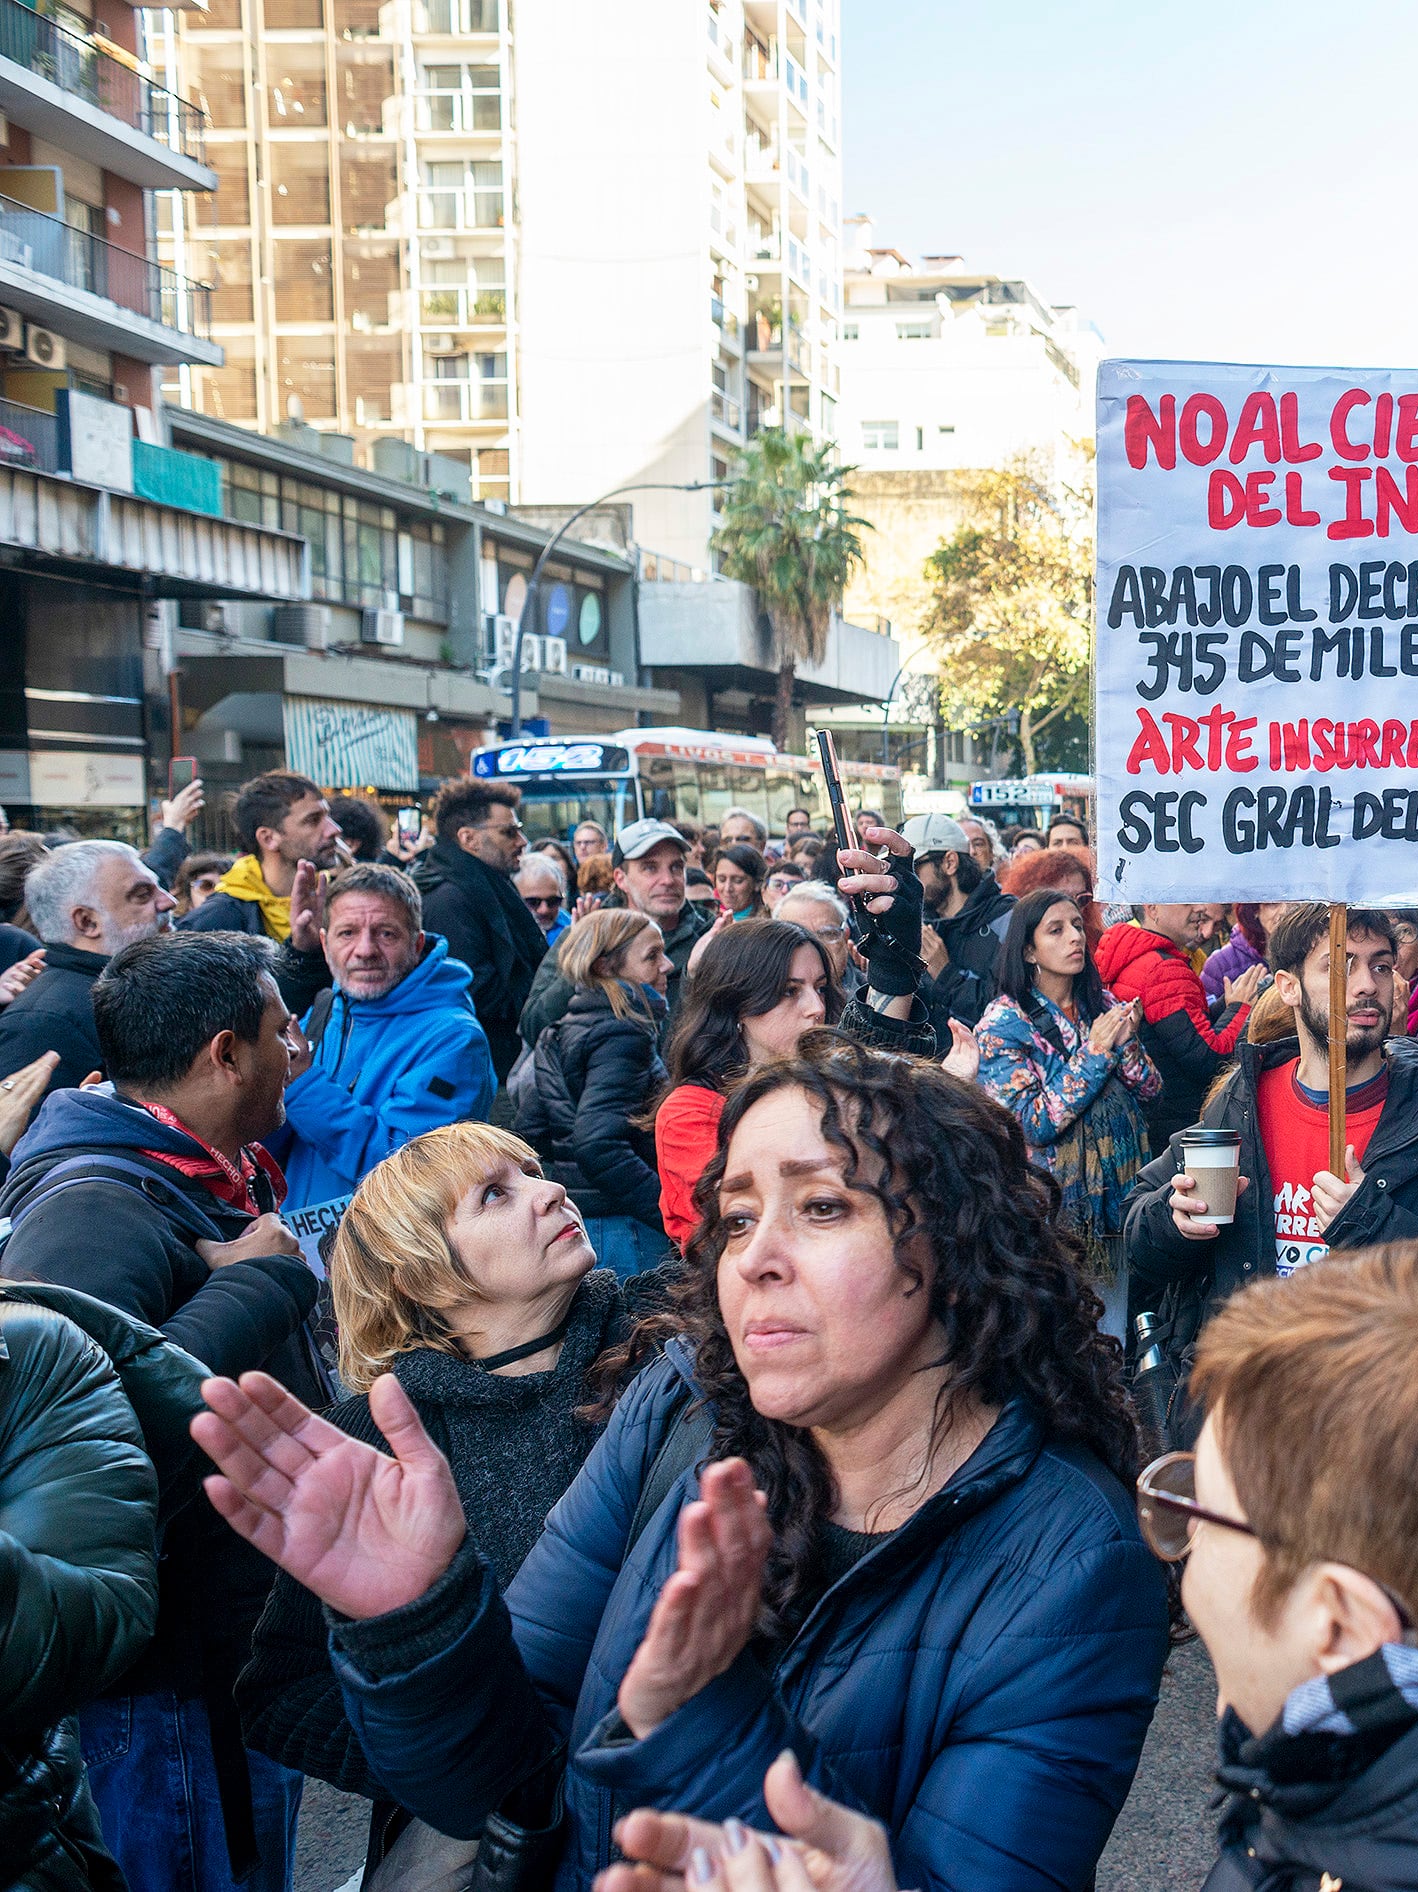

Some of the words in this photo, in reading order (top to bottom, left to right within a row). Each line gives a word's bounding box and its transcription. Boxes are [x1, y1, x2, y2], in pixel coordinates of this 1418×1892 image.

[1124, 393, 1229, 471] NO
[1228, 391, 1323, 465] AL
[1207, 464, 1321, 531] DEL
[1106, 564, 1254, 630] ABAJO
[1257, 563, 1318, 627] EL
[1135, 629, 1229, 702] 345
[1237, 628, 1305, 684] DE
[497, 744, 604, 773] 152
[1126, 703, 1259, 776] ARTE
[986, 787, 1028, 801] 152
[1116, 790, 1208, 854] SEC
[1222, 784, 1341, 856] GRAL
[1275, 1213, 1320, 1238] RRE
